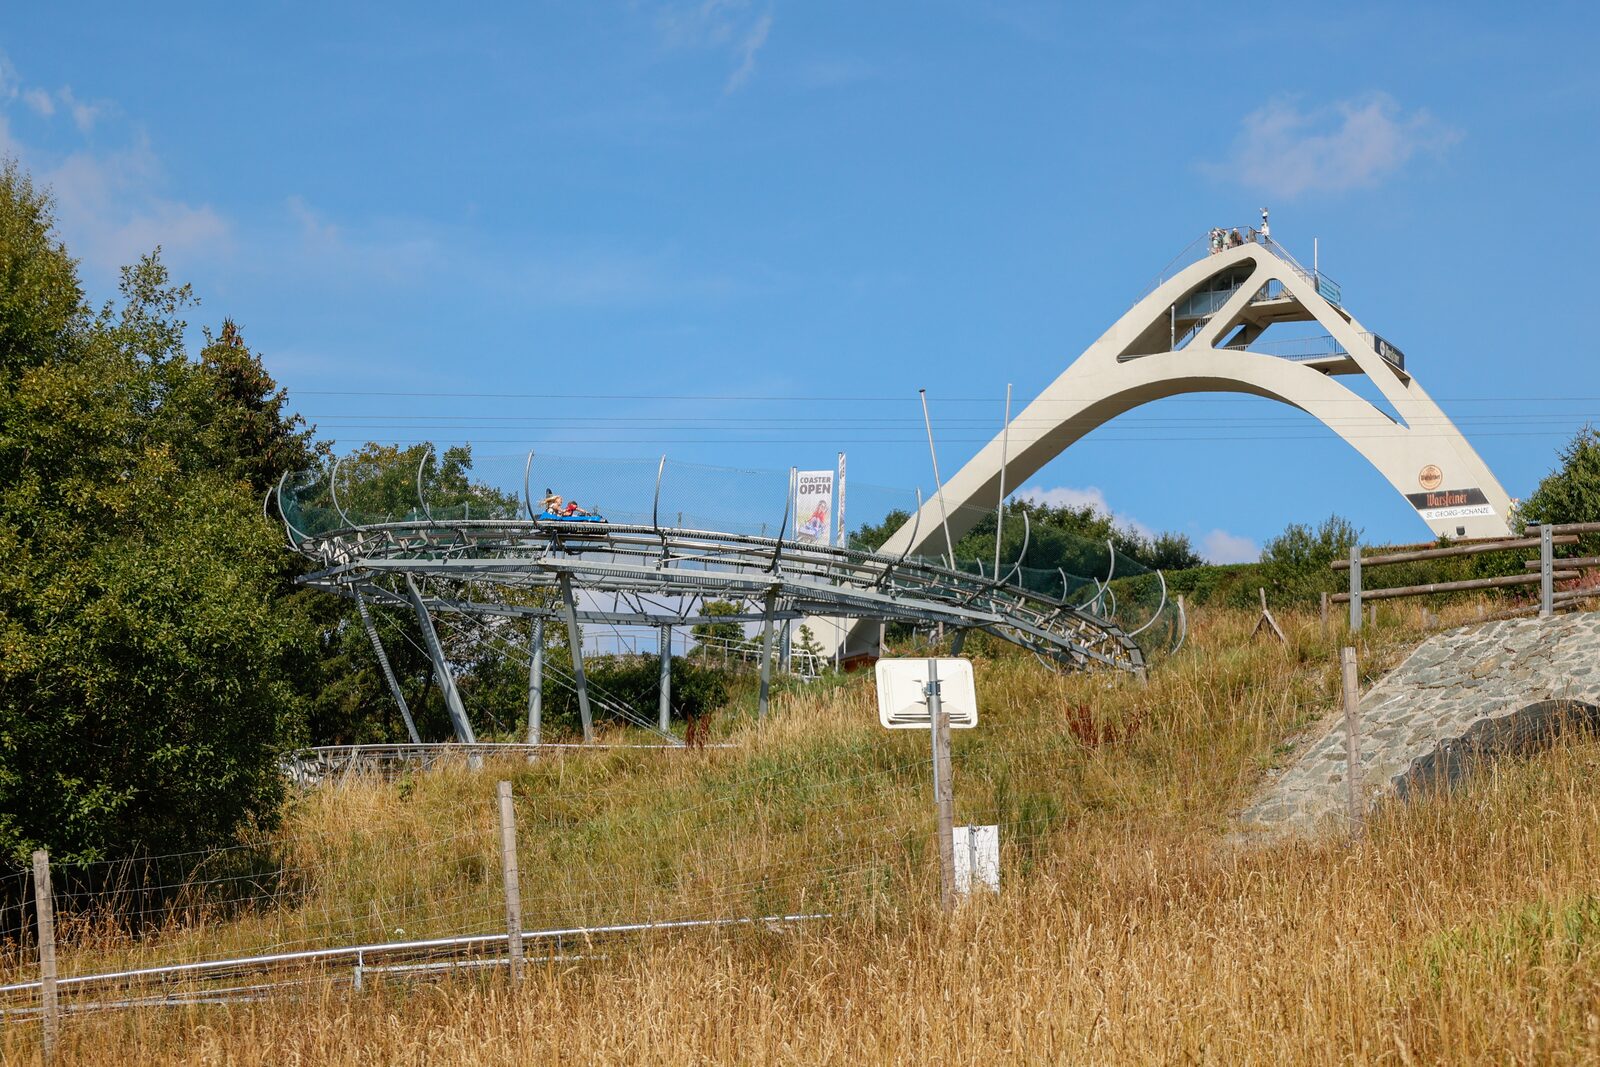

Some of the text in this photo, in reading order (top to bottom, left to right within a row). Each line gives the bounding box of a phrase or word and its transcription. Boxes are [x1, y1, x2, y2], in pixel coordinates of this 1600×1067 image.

[800, 476, 831, 484] COASTER
[800, 484, 831, 494] OPEN
[1427, 491, 1467, 506] Warsteiner
[1435, 507, 1489, 517] GEORG-SCHANZE
